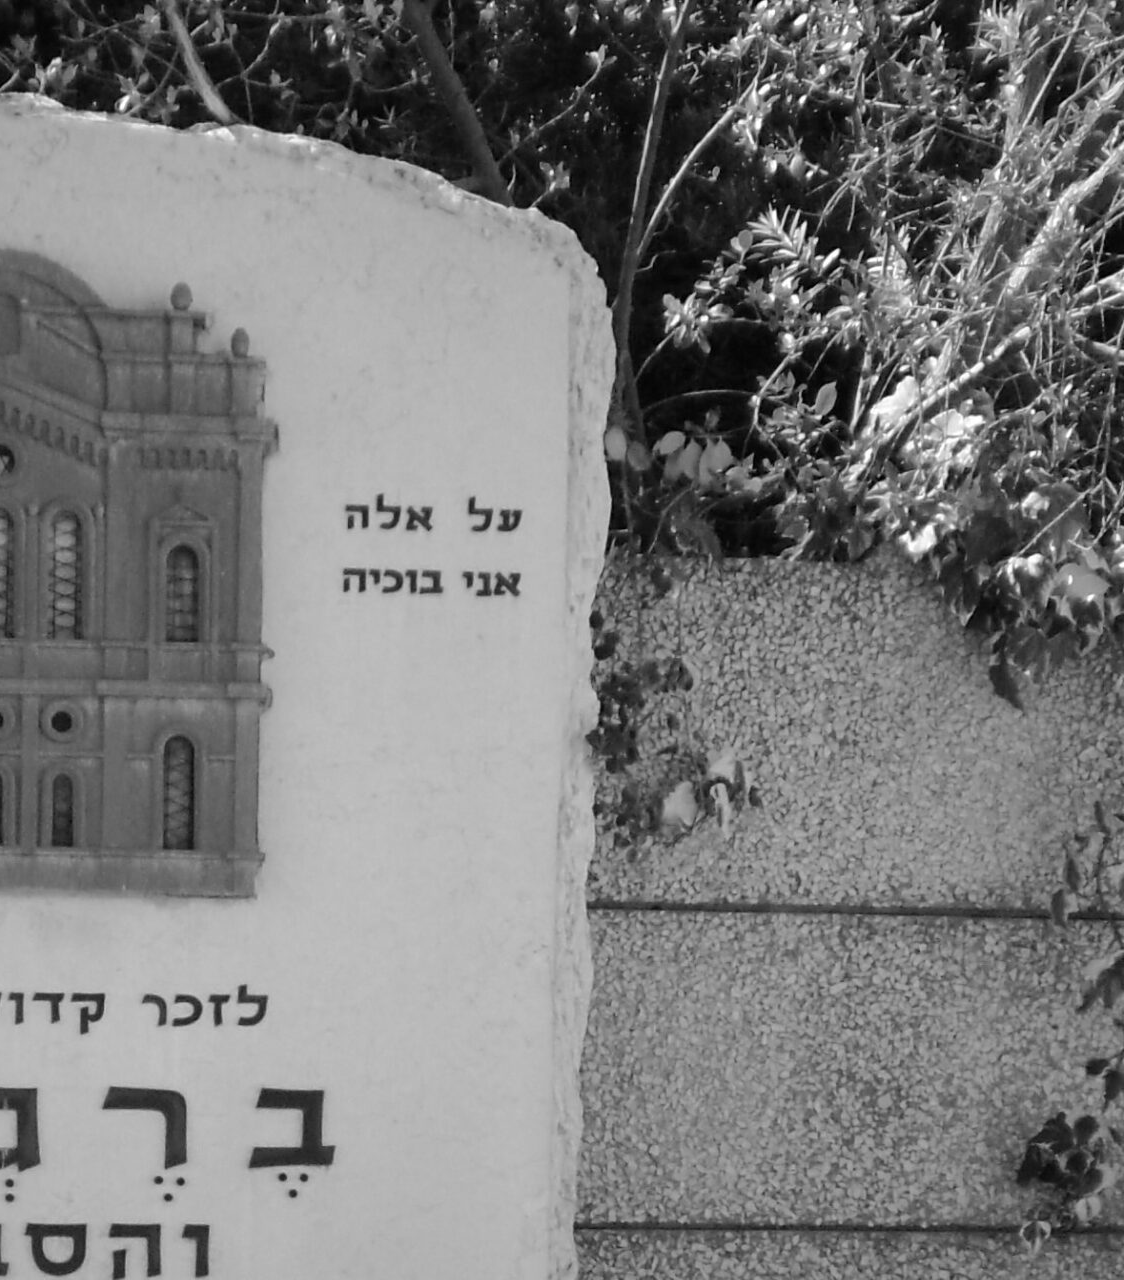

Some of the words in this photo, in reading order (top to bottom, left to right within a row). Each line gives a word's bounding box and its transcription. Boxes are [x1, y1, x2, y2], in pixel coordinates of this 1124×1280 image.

[344, 493, 433, 532] אלה
[467, 496, 523, 533] על
[342, 567, 444, 595] בוכיה
[462, 571, 521, 597] אני
[141, 984, 269, 1027] לזכר
